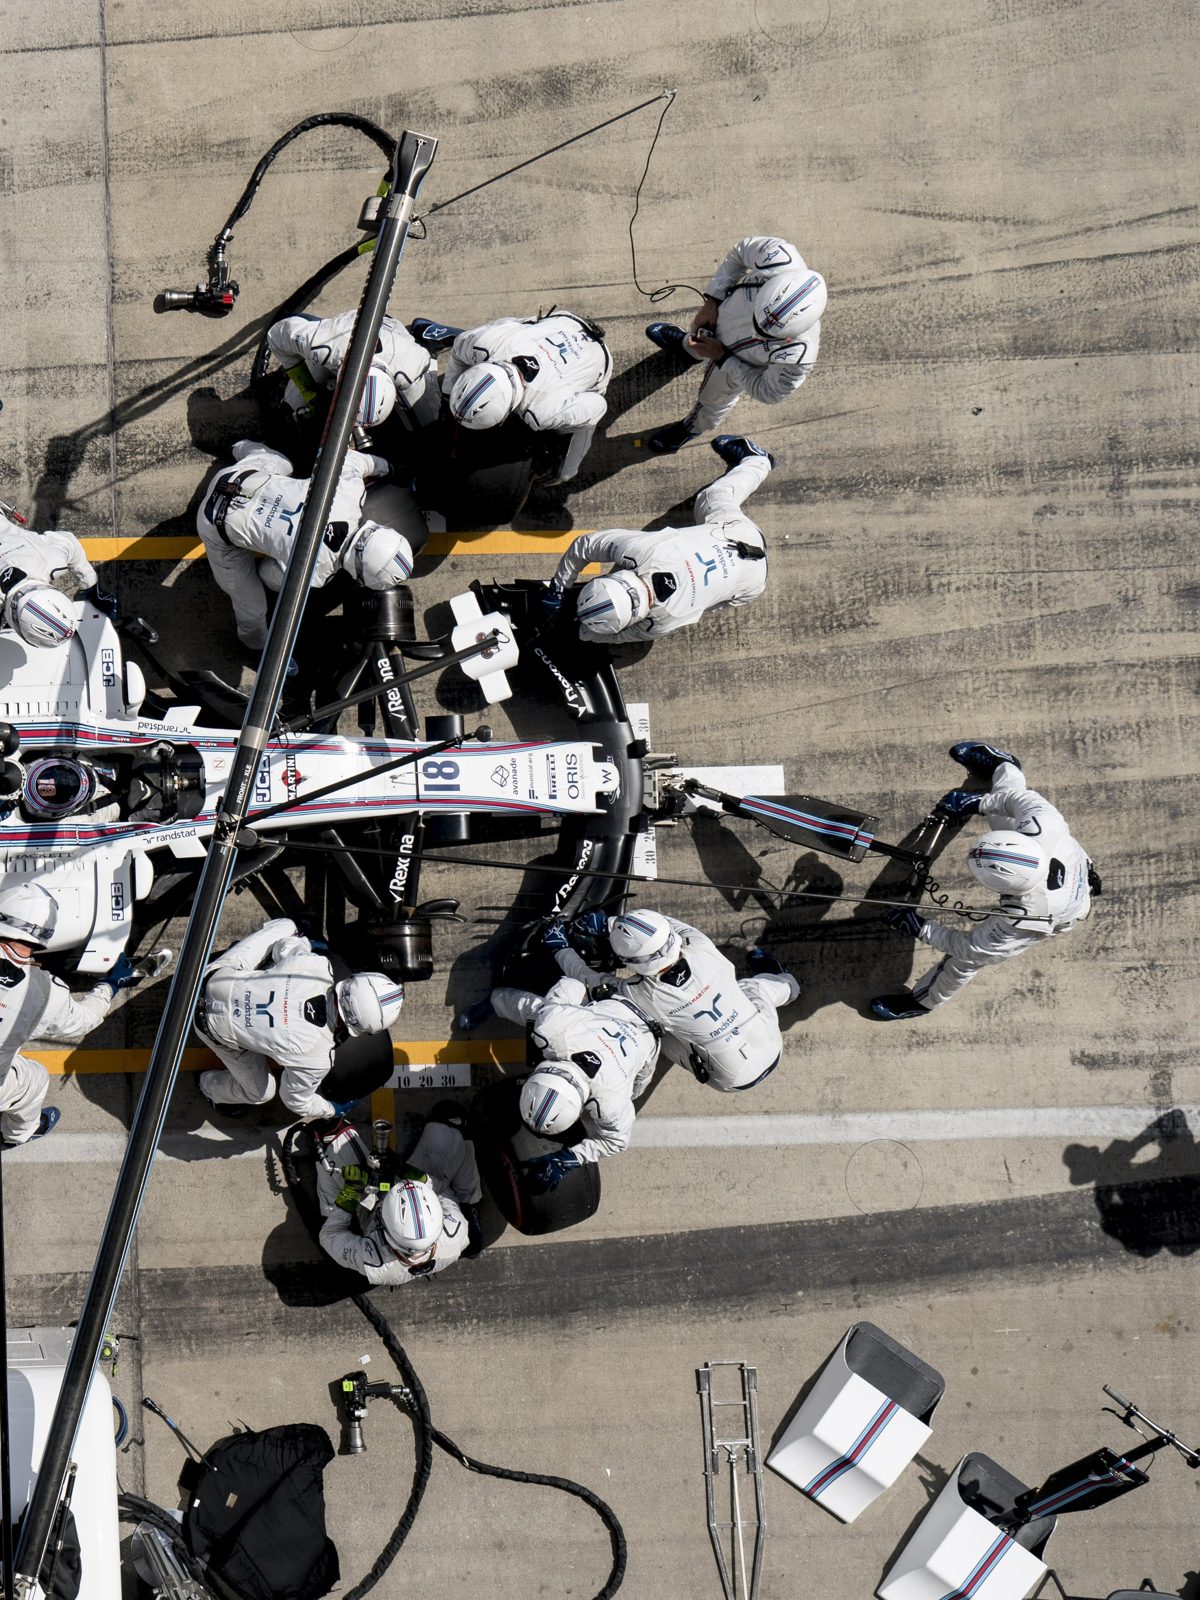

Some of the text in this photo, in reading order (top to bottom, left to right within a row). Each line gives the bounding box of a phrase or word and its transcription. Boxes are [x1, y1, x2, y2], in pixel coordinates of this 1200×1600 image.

[264, 493, 283, 528] randstad
[711, 543, 729, 578] randstad
[102, 649, 114, 687] JCB
[138, 721, 176, 734] randstad
[288, 756, 296, 800] MARTINI
[422, 760, 460, 792] 18
[566, 754, 579, 799] ORIS
[156, 828, 196, 842] randstad
[111, 882, 124, 920] JCB
[245, 990, 253, 1027] randstad
[709, 1008, 738, 1037] randstad
[397, 1076, 456, 1088] 10 20 30
